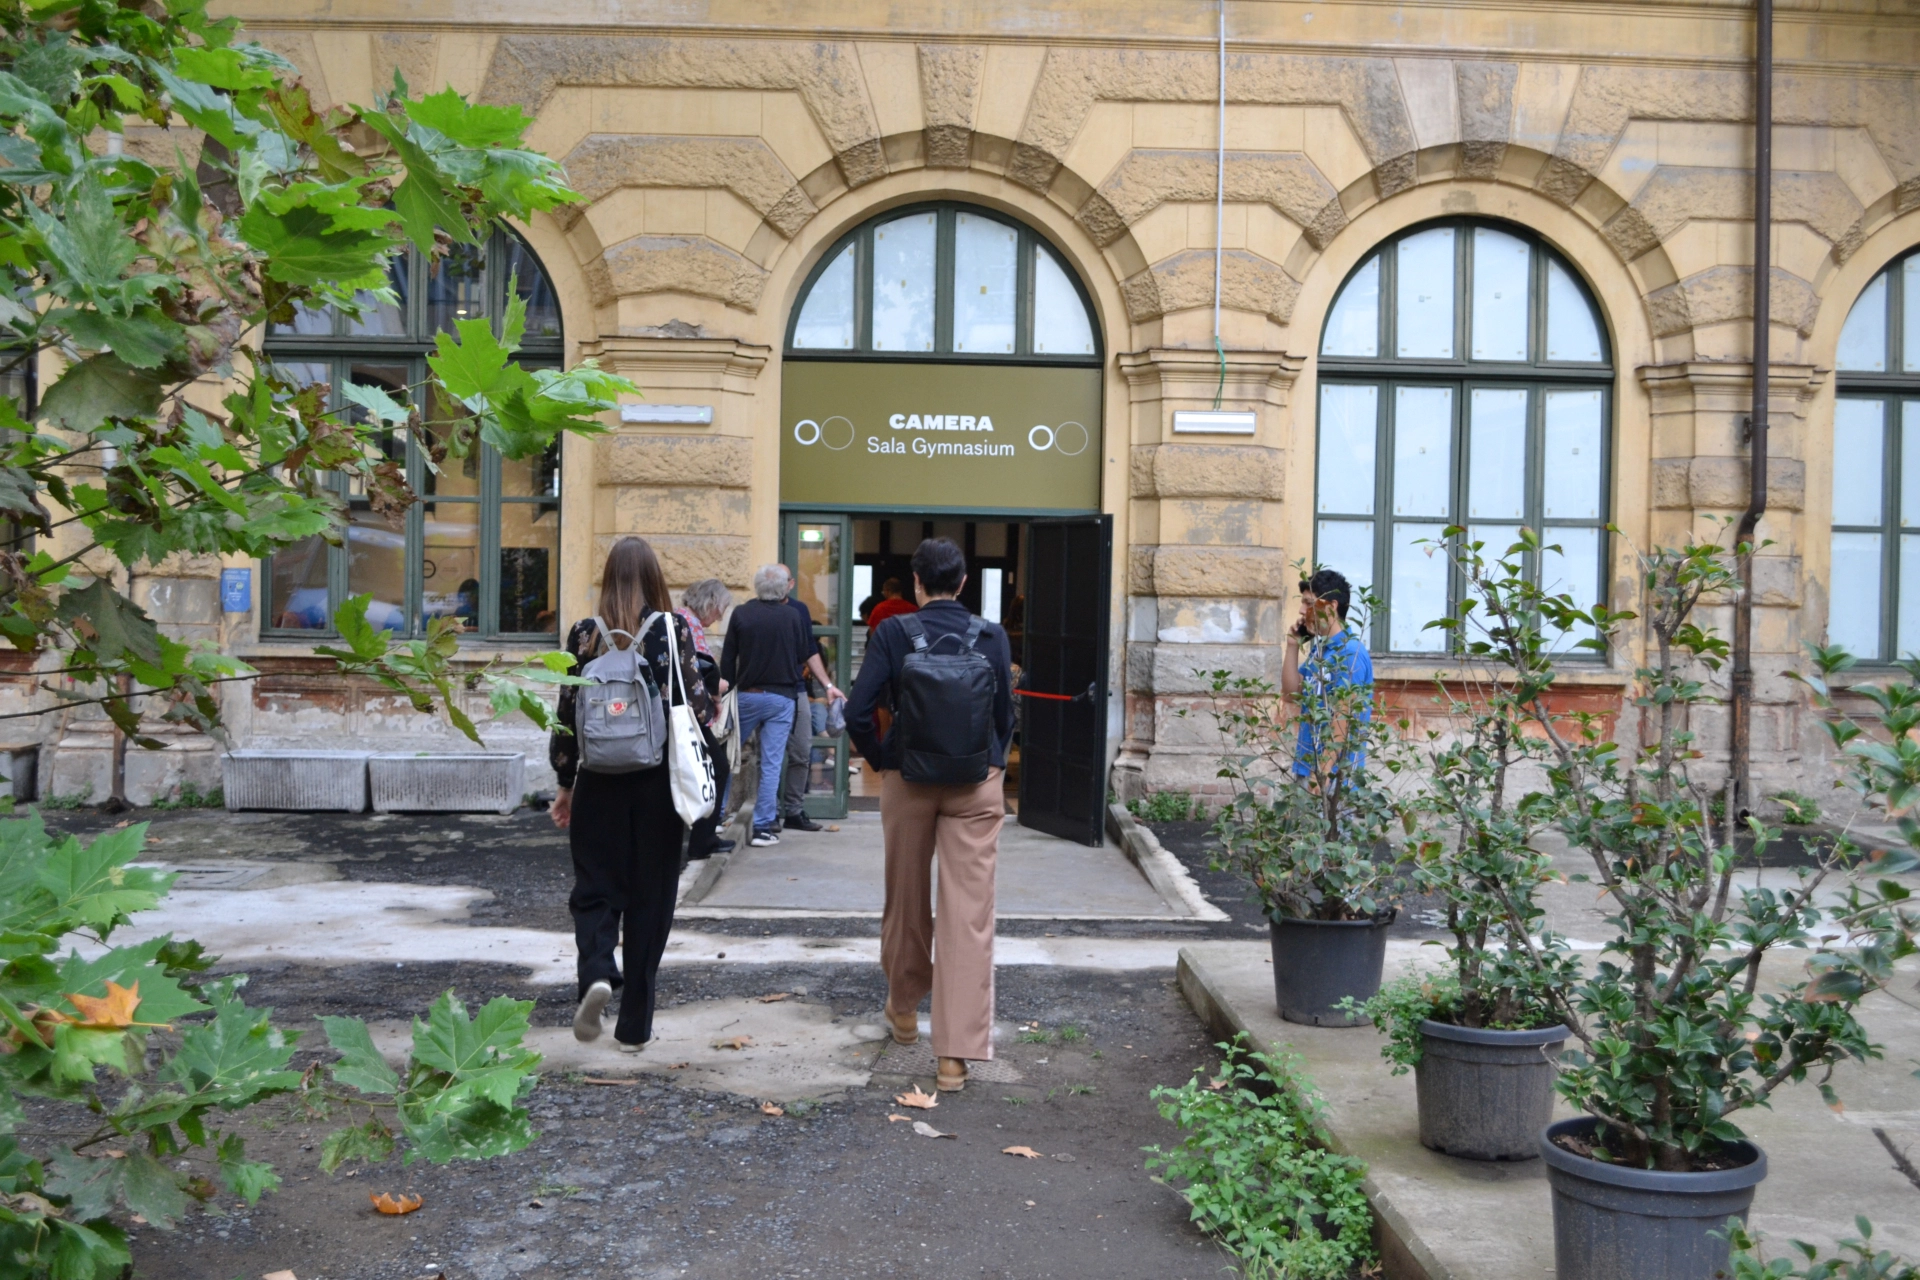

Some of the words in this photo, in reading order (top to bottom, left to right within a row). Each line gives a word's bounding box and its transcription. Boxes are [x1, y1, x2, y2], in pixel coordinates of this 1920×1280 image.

[889, 413, 994, 432] CAMERA
[867, 436, 906, 454] Sala
[912, 437, 1015, 459] Gymnasium
